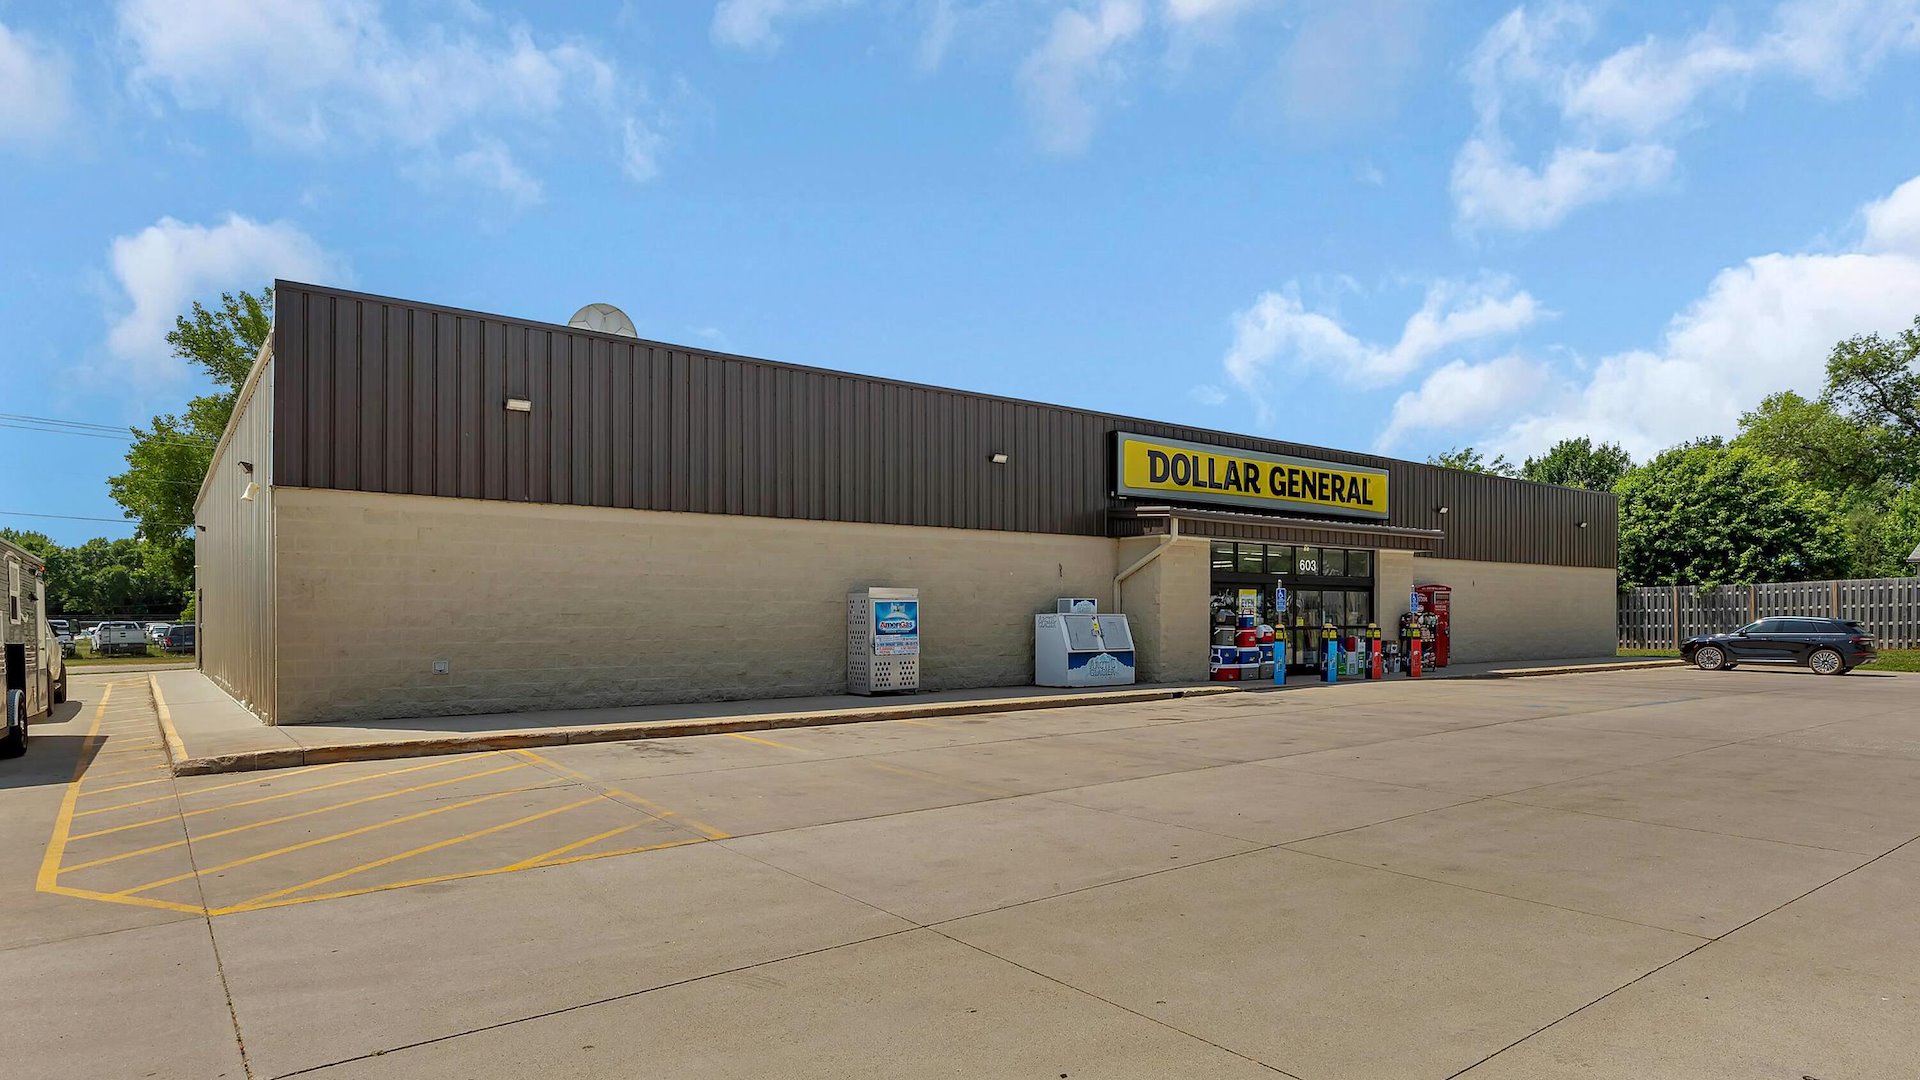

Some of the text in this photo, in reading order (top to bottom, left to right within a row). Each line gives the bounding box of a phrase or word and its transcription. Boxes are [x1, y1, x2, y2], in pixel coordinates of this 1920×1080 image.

[1147, 449, 1374, 506] DOLLAR GENERAL
[1299, 559, 1317, 571] 603
